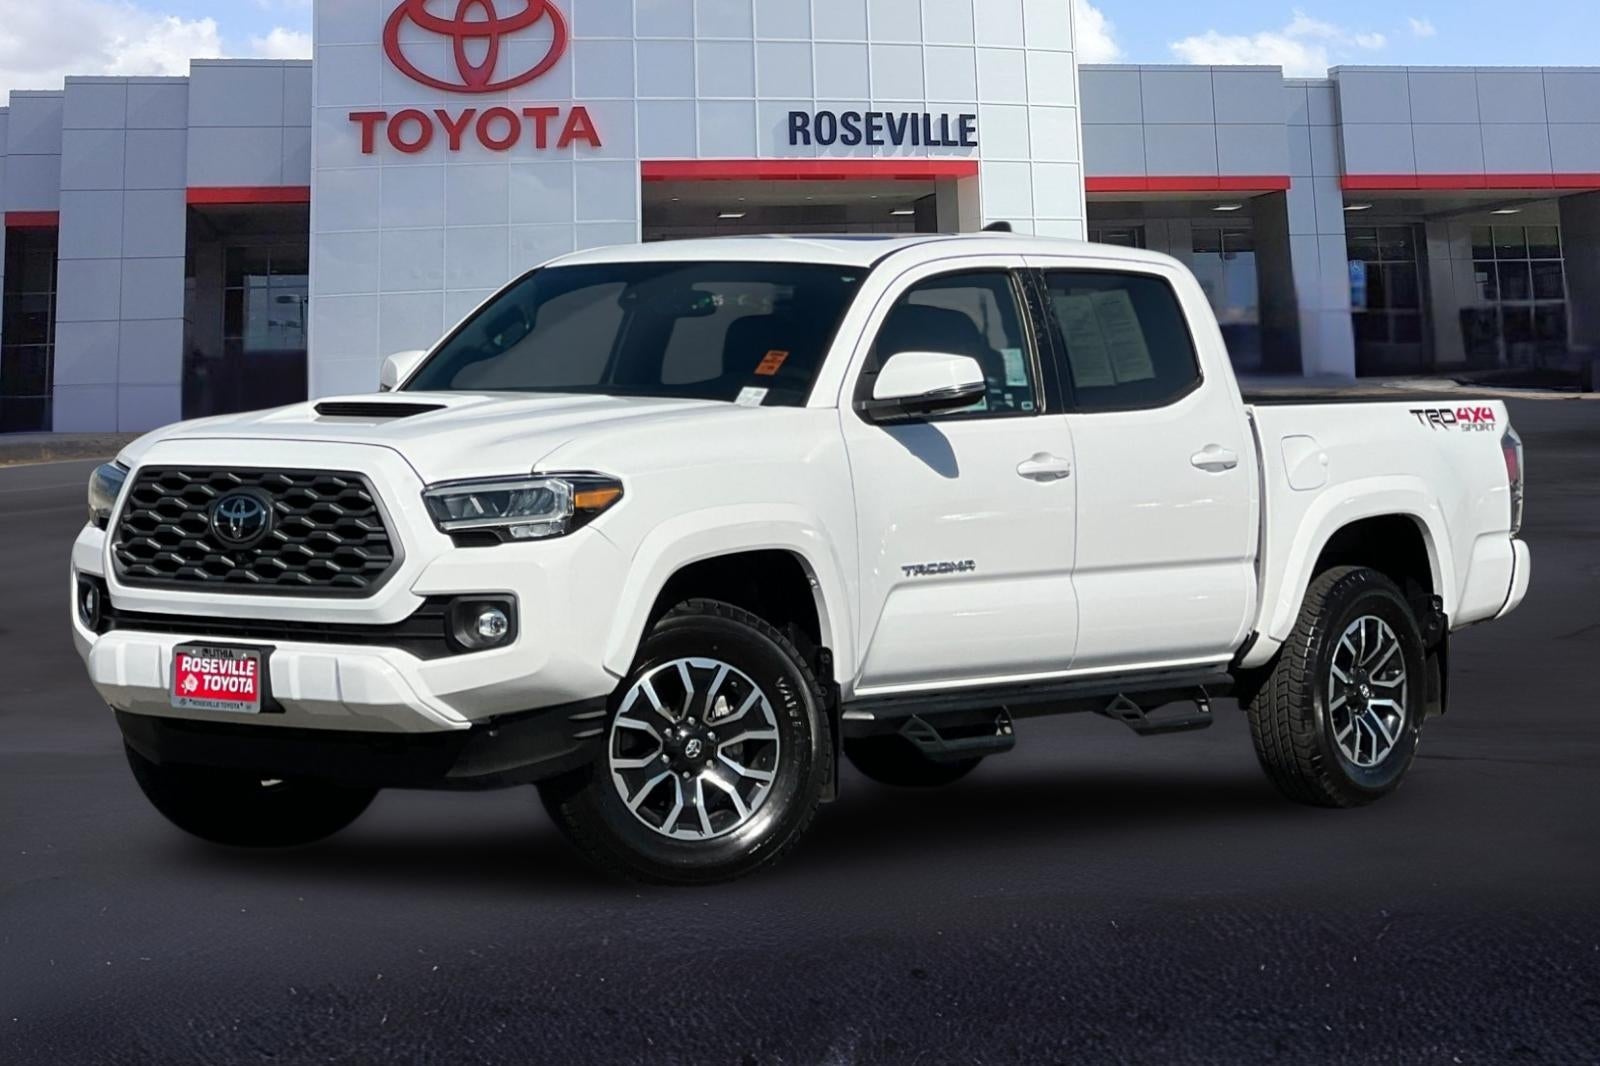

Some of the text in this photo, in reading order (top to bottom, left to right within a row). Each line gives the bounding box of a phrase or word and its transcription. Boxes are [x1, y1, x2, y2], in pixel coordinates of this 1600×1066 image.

[349, 106, 602, 154] TOYOTA
[788, 111, 978, 147] ROSEVILLE
[1409, 408, 1457, 431] TRD
[1461, 423, 1496, 432] SPORT
[901, 560, 976, 577] TACOMA
[209, 649, 234, 658] LITHIA
[181, 656, 255, 675] ROSEVILLE
[203, 674, 254, 694] TOYOTA
